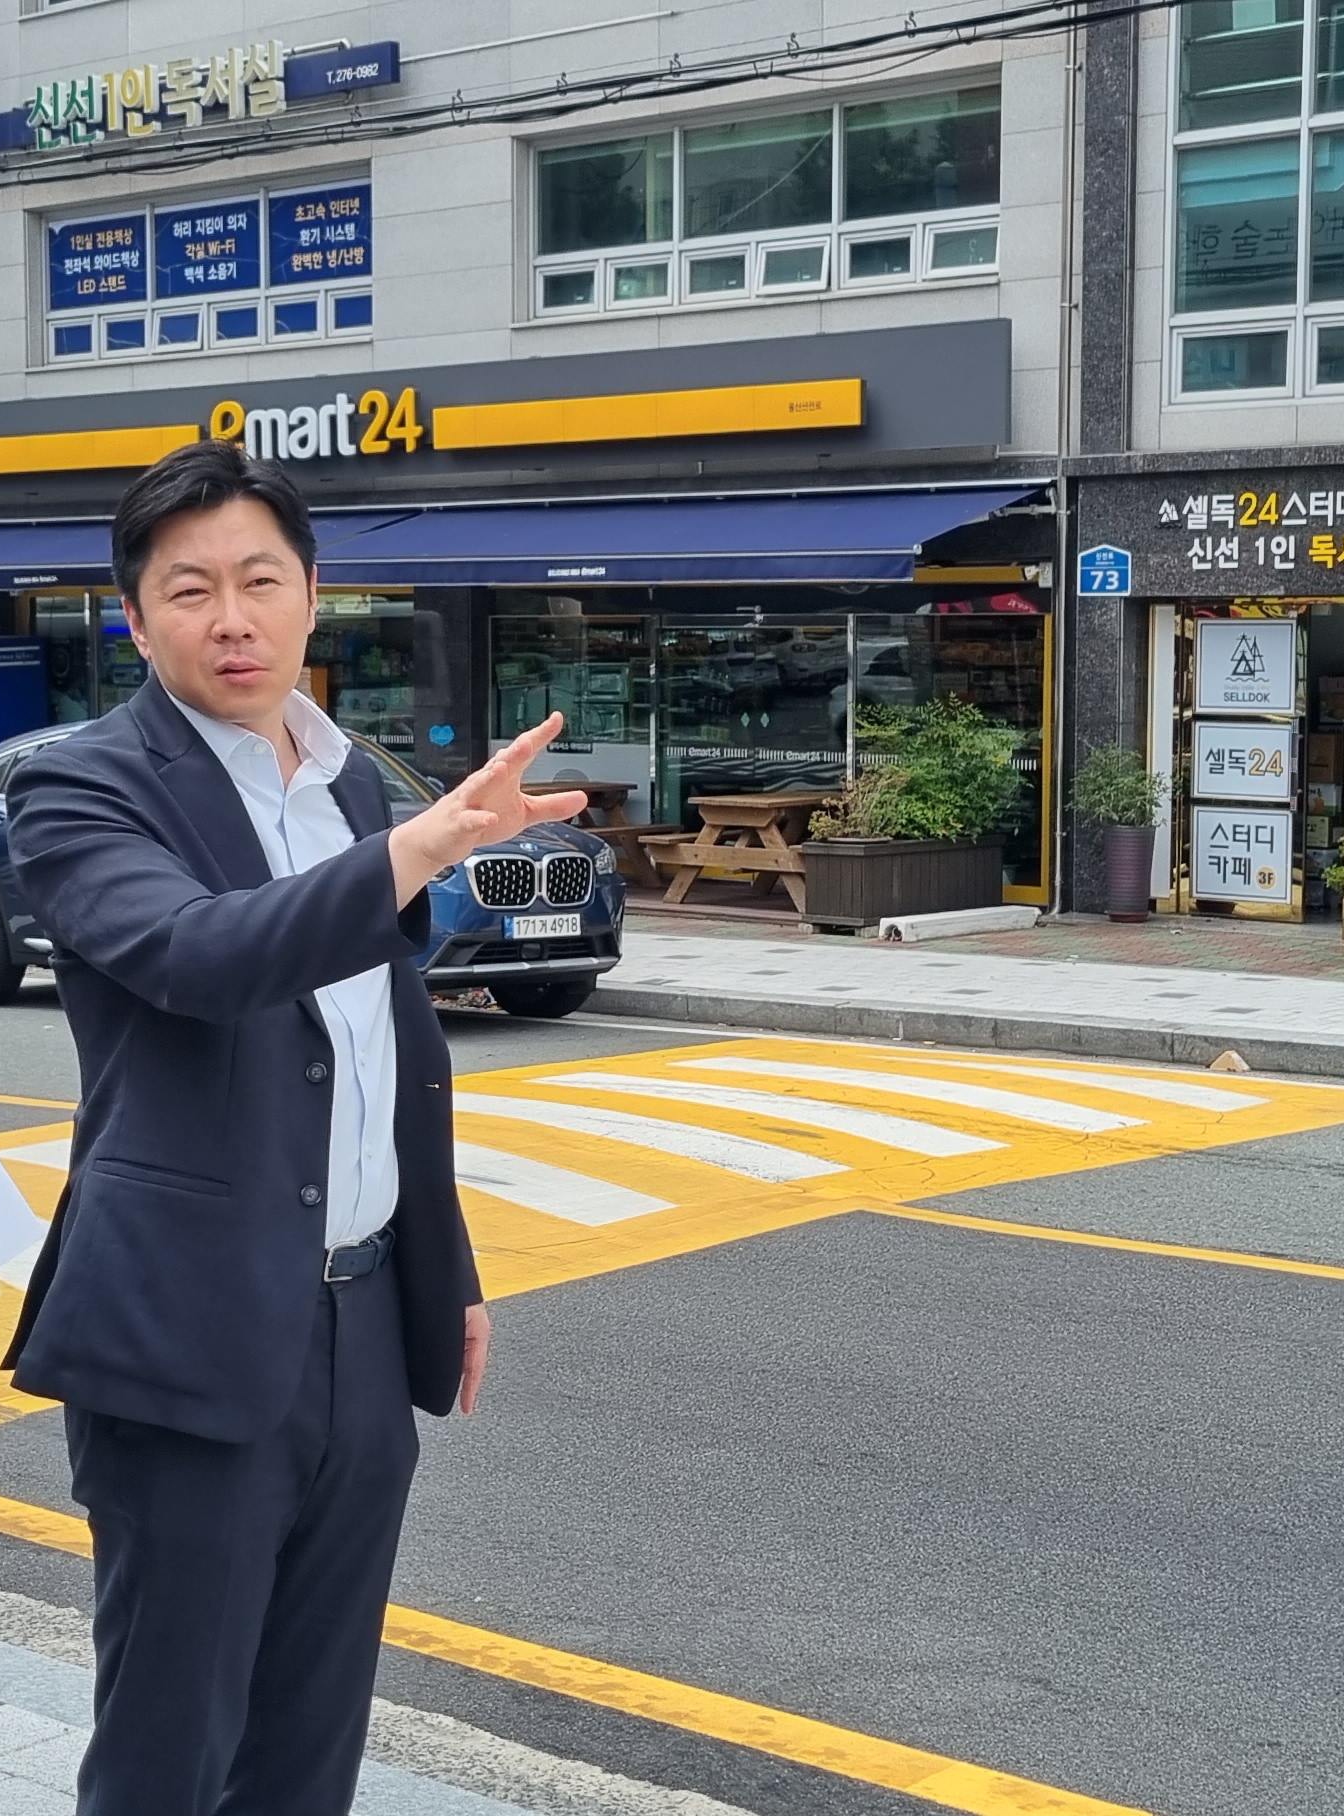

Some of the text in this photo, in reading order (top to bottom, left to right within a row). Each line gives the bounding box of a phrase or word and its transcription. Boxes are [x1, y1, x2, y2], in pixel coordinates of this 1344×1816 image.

[294, 197, 360, 222] 초고속 인터넷
[173, 212, 247, 239] 허리 지킴이 의자
[300, 223, 356, 247] 환기 시스템
[70, 232, 93, 250] 1인실
[185, 238, 236, 261] 각실 Wi-Fi
[207, 261, 237, 281] 소음기
[291, 253, 323, 273] 완벽한
[77, 275, 127, 295] LED 스탠드
[209, 387, 423, 461] emart24
[1187, 535, 1240, 570] 신선
[1254, 535, 1296, 570] 1인
[1090, 571, 1120, 590] 73
[1223, 692, 1271, 703] SELLDOK
[1205, 748, 1284, 776] 셀독24
[1209, 822, 1275, 853] 스터디
[1208, 855, 1274, 886] 카페 3F
